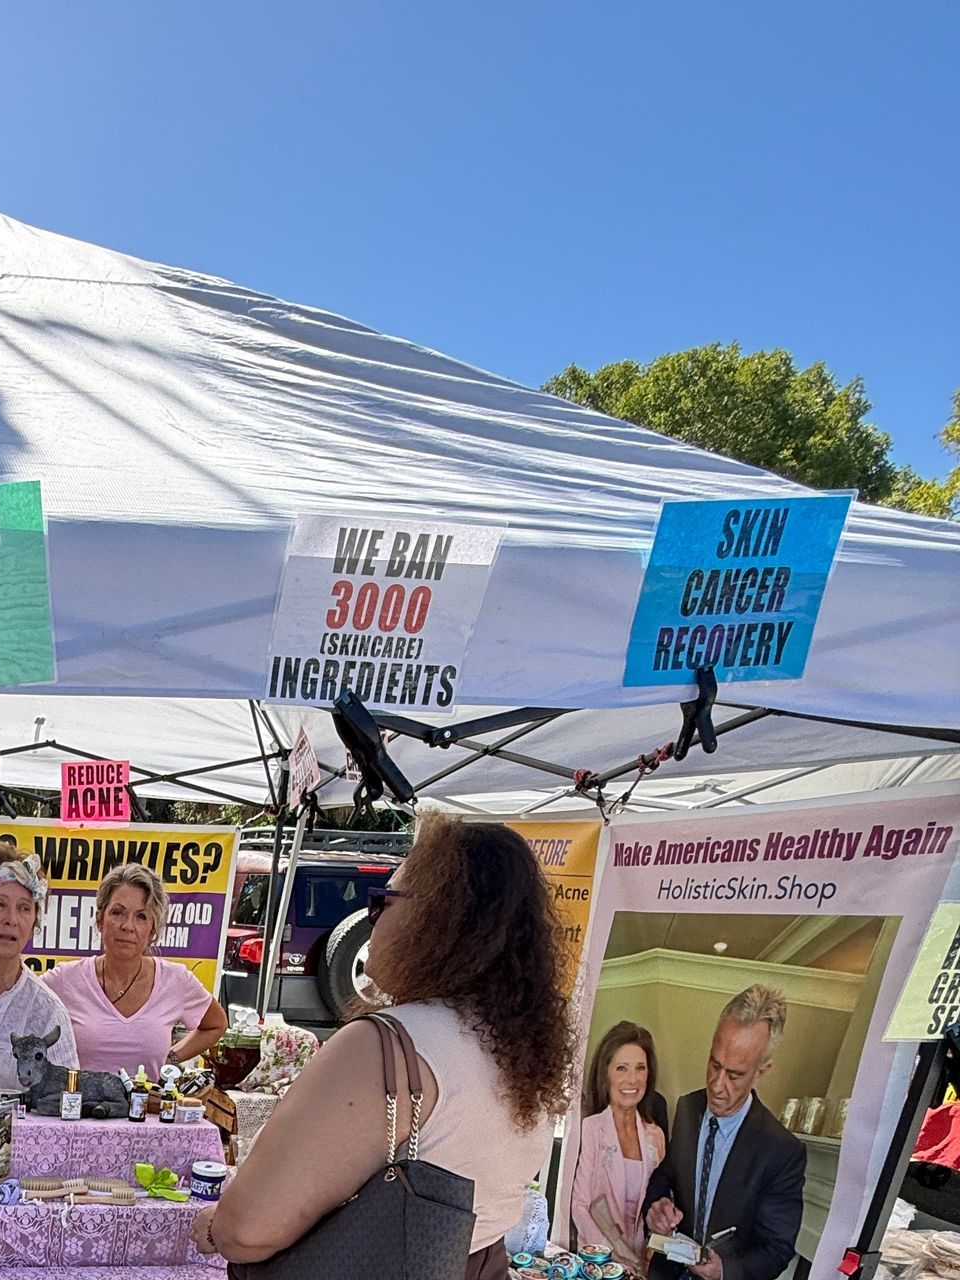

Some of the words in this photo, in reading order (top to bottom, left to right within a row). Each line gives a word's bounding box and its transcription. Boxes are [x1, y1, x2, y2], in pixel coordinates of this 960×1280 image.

[716, 508, 790, 559] SKIN
[332, 527, 385, 576] WE
[385, 531, 454, 581] BAN
[325, 580, 432, 634] 3000
[679, 566, 791, 617] CANCER
[652, 621, 794, 672] RECOVERY
[268, 656, 457, 707] INGREDIENTS
[67, 764, 123, 786] REDUCE
[67, 786, 124, 819] ACNE
[527, 839, 573, 867] EFORE
[613, 842, 651, 867] Make
[653, 836, 760, 866] Americans
[763, 828, 862, 862] Healthy
[862, 821, 953, 861] Again
[554, 884, 589, 901] Acne
[657, 875, 836, 908] HolisticSkin.Shop
[184, 902, 213, 925] OLD
[157, 927, 189, 948] ARM
